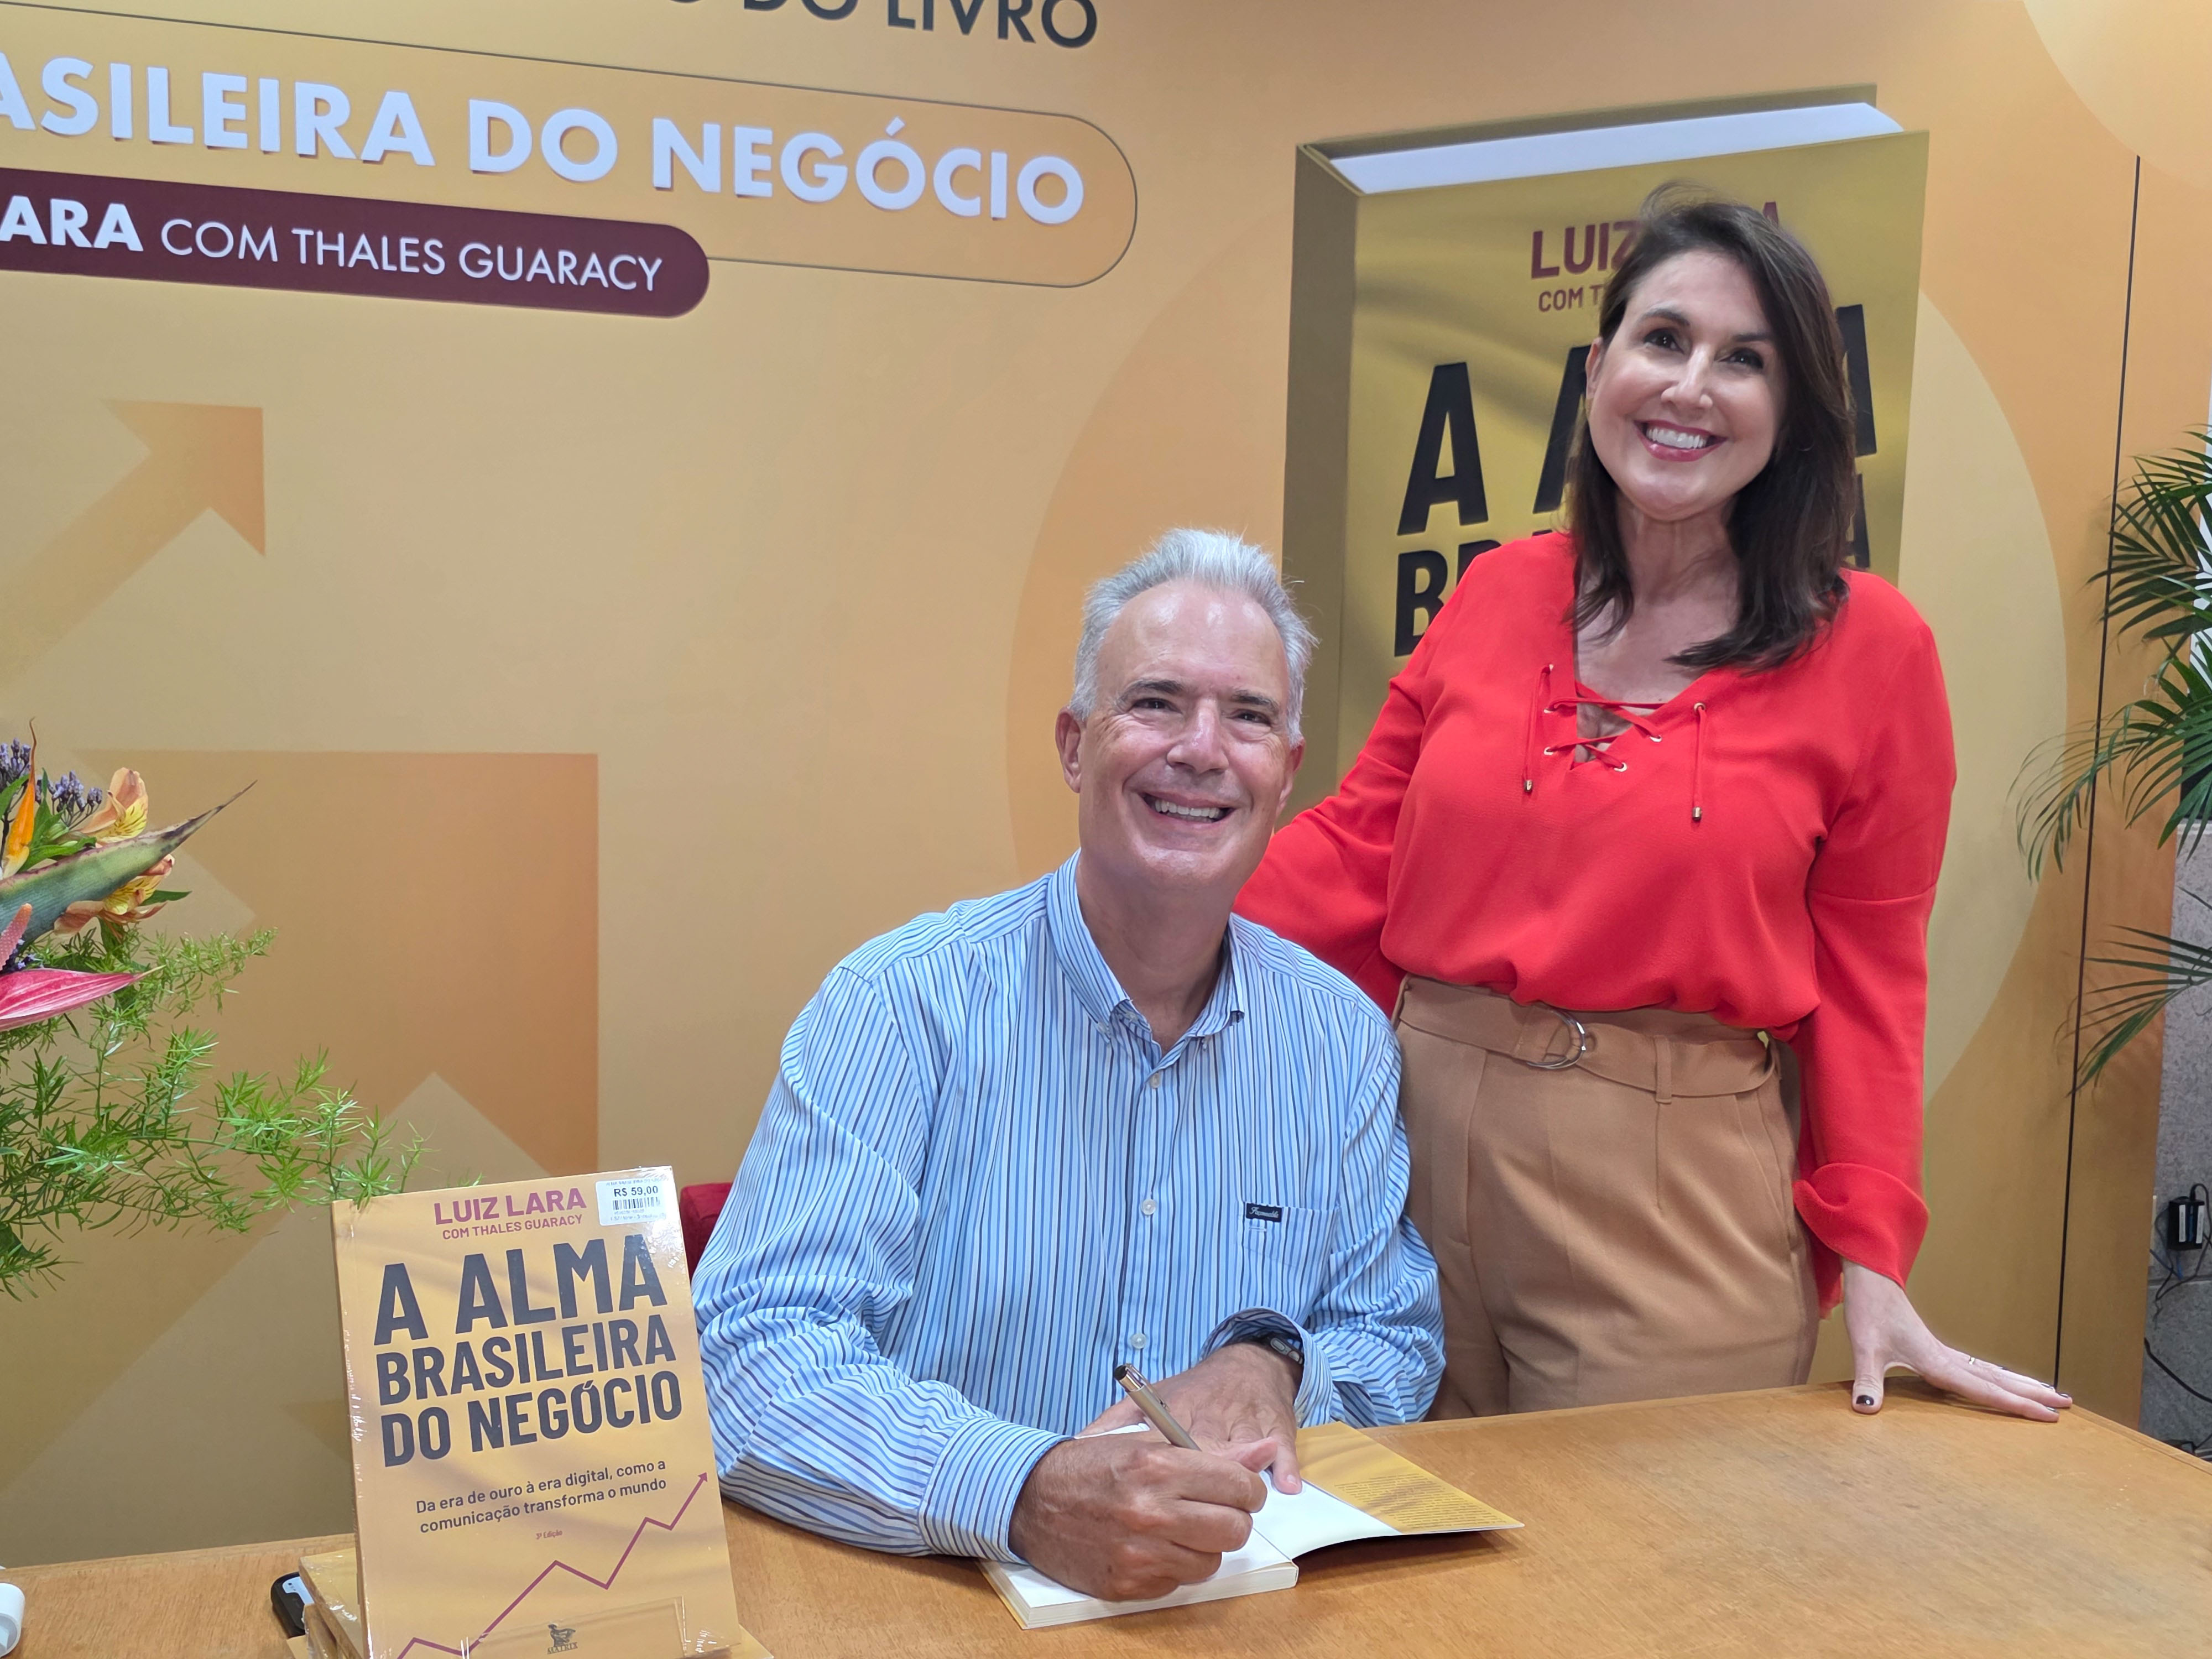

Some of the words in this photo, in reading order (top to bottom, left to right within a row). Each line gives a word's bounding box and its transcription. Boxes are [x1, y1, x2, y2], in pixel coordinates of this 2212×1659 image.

[887, 0, 1098, 49] LIVRO
[468, 98, 618, 182] DO
[653, 117, 1084, 224] NEGÓCIO
[0, 195, 144, 252] ARA
[161, 218, 278, 262] COM
[291, 228, 445, 275] THALES
[459, 243, 662, 291] GUARACY
[1531, 220, 1642, 279] LUIZ
[1538, 285, 1583, 313] COM
[1397, 362, 1489, 536] A
[434, 1196, 500, 1225] LUIZ
[505, 1188, 587, 1217] LARA
[613, 1187, 628, 1197] R$
[631, 1185, 659, 1197] 59,00
[442, 1227, 469, 1240] COM
[472, 1221, 522, 1237] THALES
[525, 1214, 583, 1230] GUARACY
[374, 1262, 428, 1346] A
[455, 1234, 667, 1334] ALMA
[376, 1314, 676, 1406] BRASILEIRA
[380, 1406, 451, 1467] DO
[467, 1370, 682, 1452] NEGÓCIO
[416, 1499, 436, 1514] Da
[440, 1495, 463, 1510] era
[467, 1490, 486, 1505] de
[489, 1486, 523, 1501] ouro
[526, 1481, 535, 1494] à
[538, 1478, 561, 1492] era
[565, 1468, 613, 1489] digital,
[616, 1463, 655, 1478] como
[658, 1460, 666, 1470] a
[420, 1504, 520, 1533] comunicação
[523, 1491, 604, 1515] transforma
[608, 1489, 616, 1499] o
[620, 1478, 666, 1497] mundo
